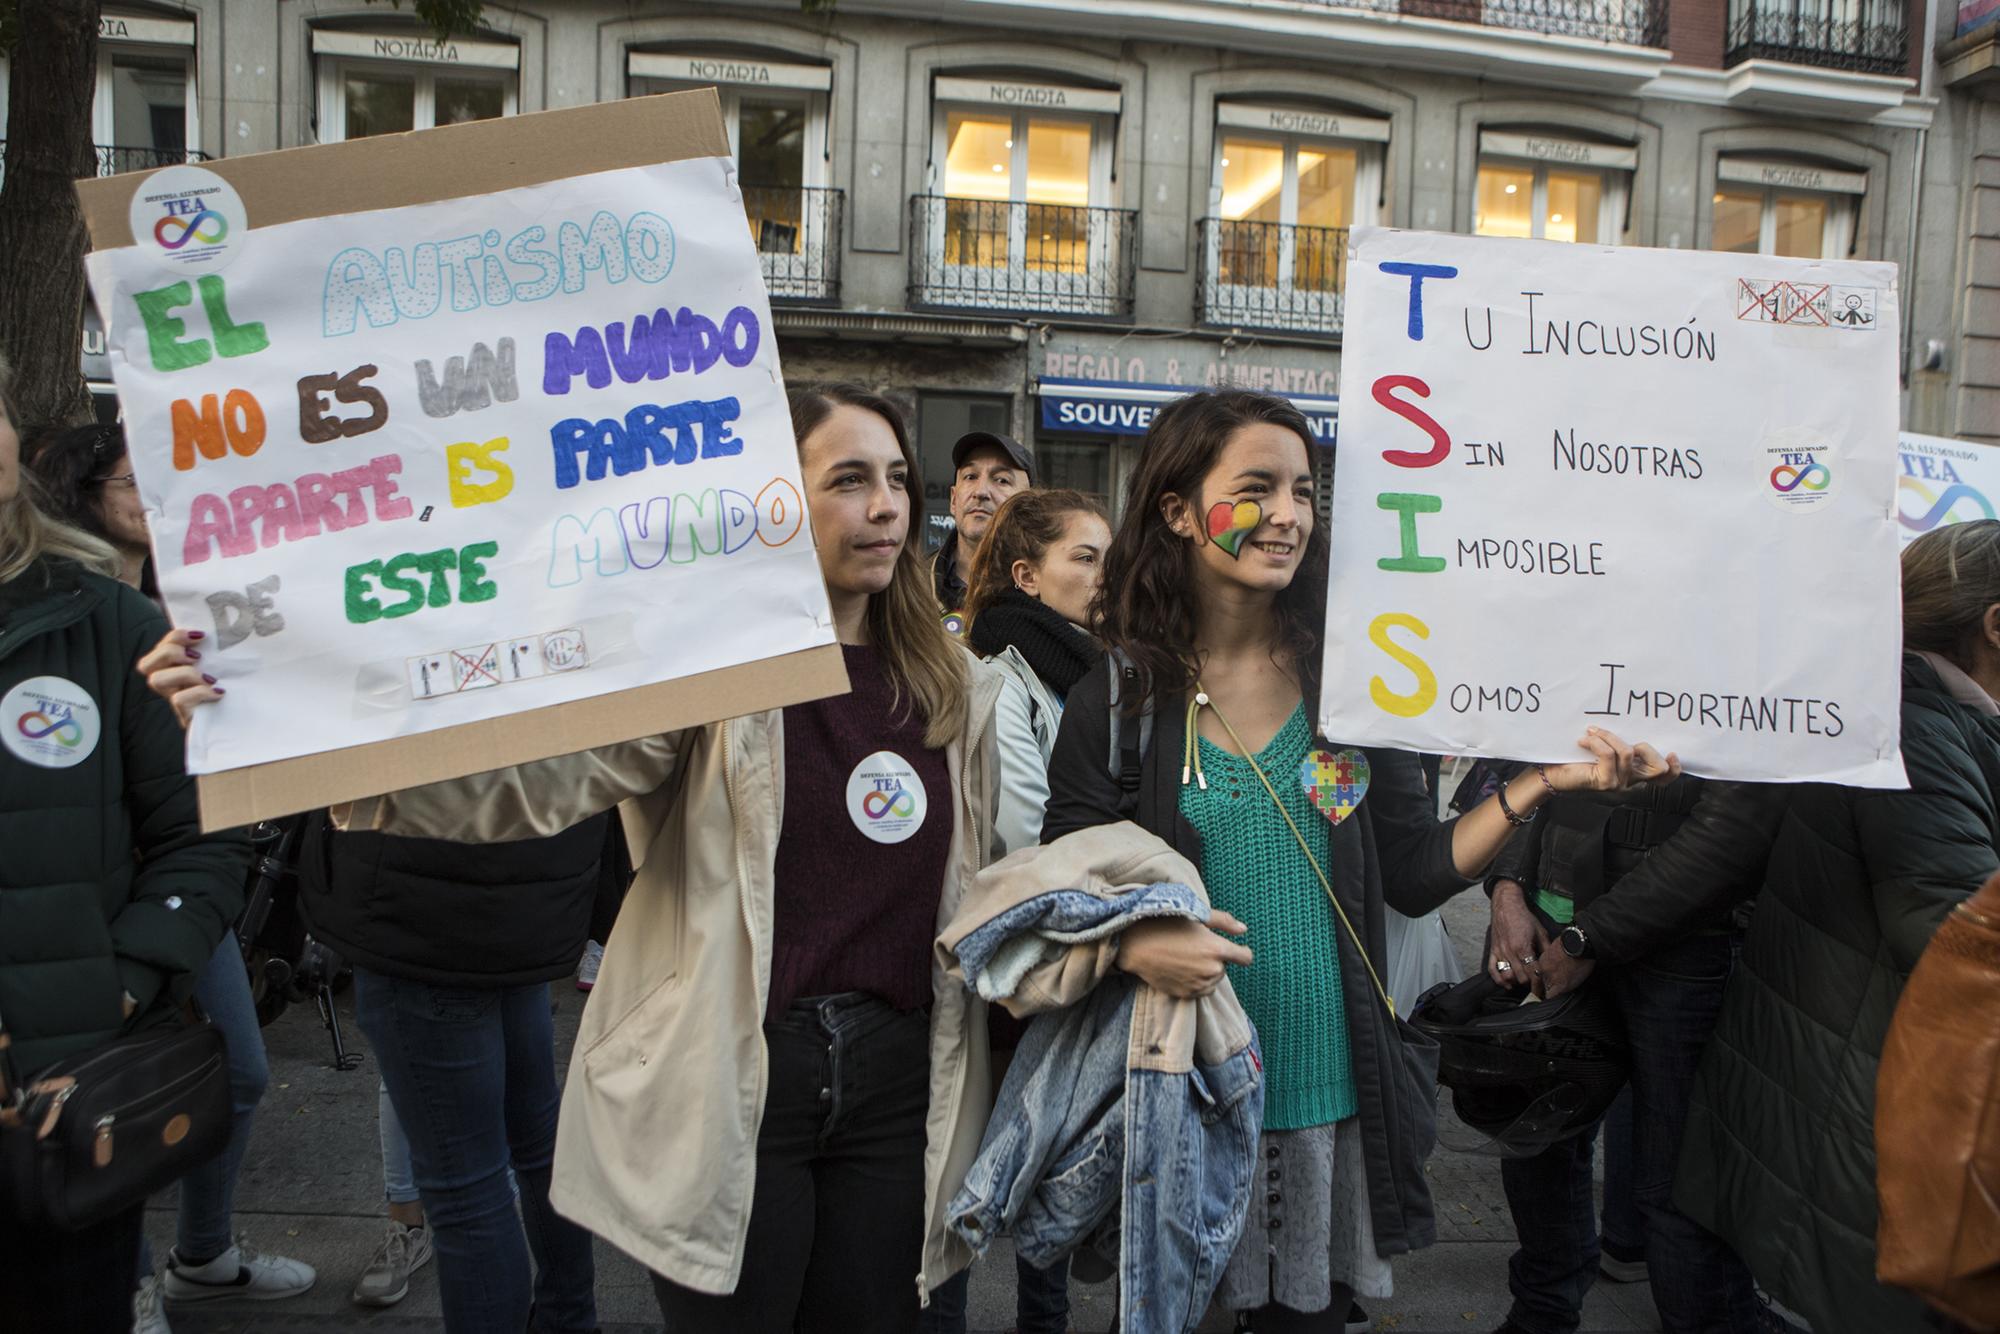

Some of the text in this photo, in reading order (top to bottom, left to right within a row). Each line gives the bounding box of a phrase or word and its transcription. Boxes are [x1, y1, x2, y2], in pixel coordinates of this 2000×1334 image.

[374, 38, 459, 61] NOTARIA
[689, 60, 769, 82] NOTARIA
[988, 85, 1066, 105] NOTARIA
[1269, 111, 1339, 135] NOTARIA
[163, 197, 208, 217] TEA
[133, 274, 269, 371] EL
[1521, 292, 1716, 362] INCLUSIÓN
[1046, 352, 1145, 383] REGALO
[1168, 358, 1182, 385] &
[171, 306, 760, 471] NO ES UN MUNDO
[446, 437, 514, 508] ES
[550, 397, 743, 489] PARTE
[1554, 428, 1702, 480] NOSOTRAS
[1781, 452, 1816, 465] TEA
[1899, 451, 1962, 484] TEA
[205, 477, 803, 651] DE ESTE MUNDO
[37, 700, 73, 720] TEA
[1585, 664, 1844, 737] IMPORTANTES
[873, 778, 903, 792] TEA
